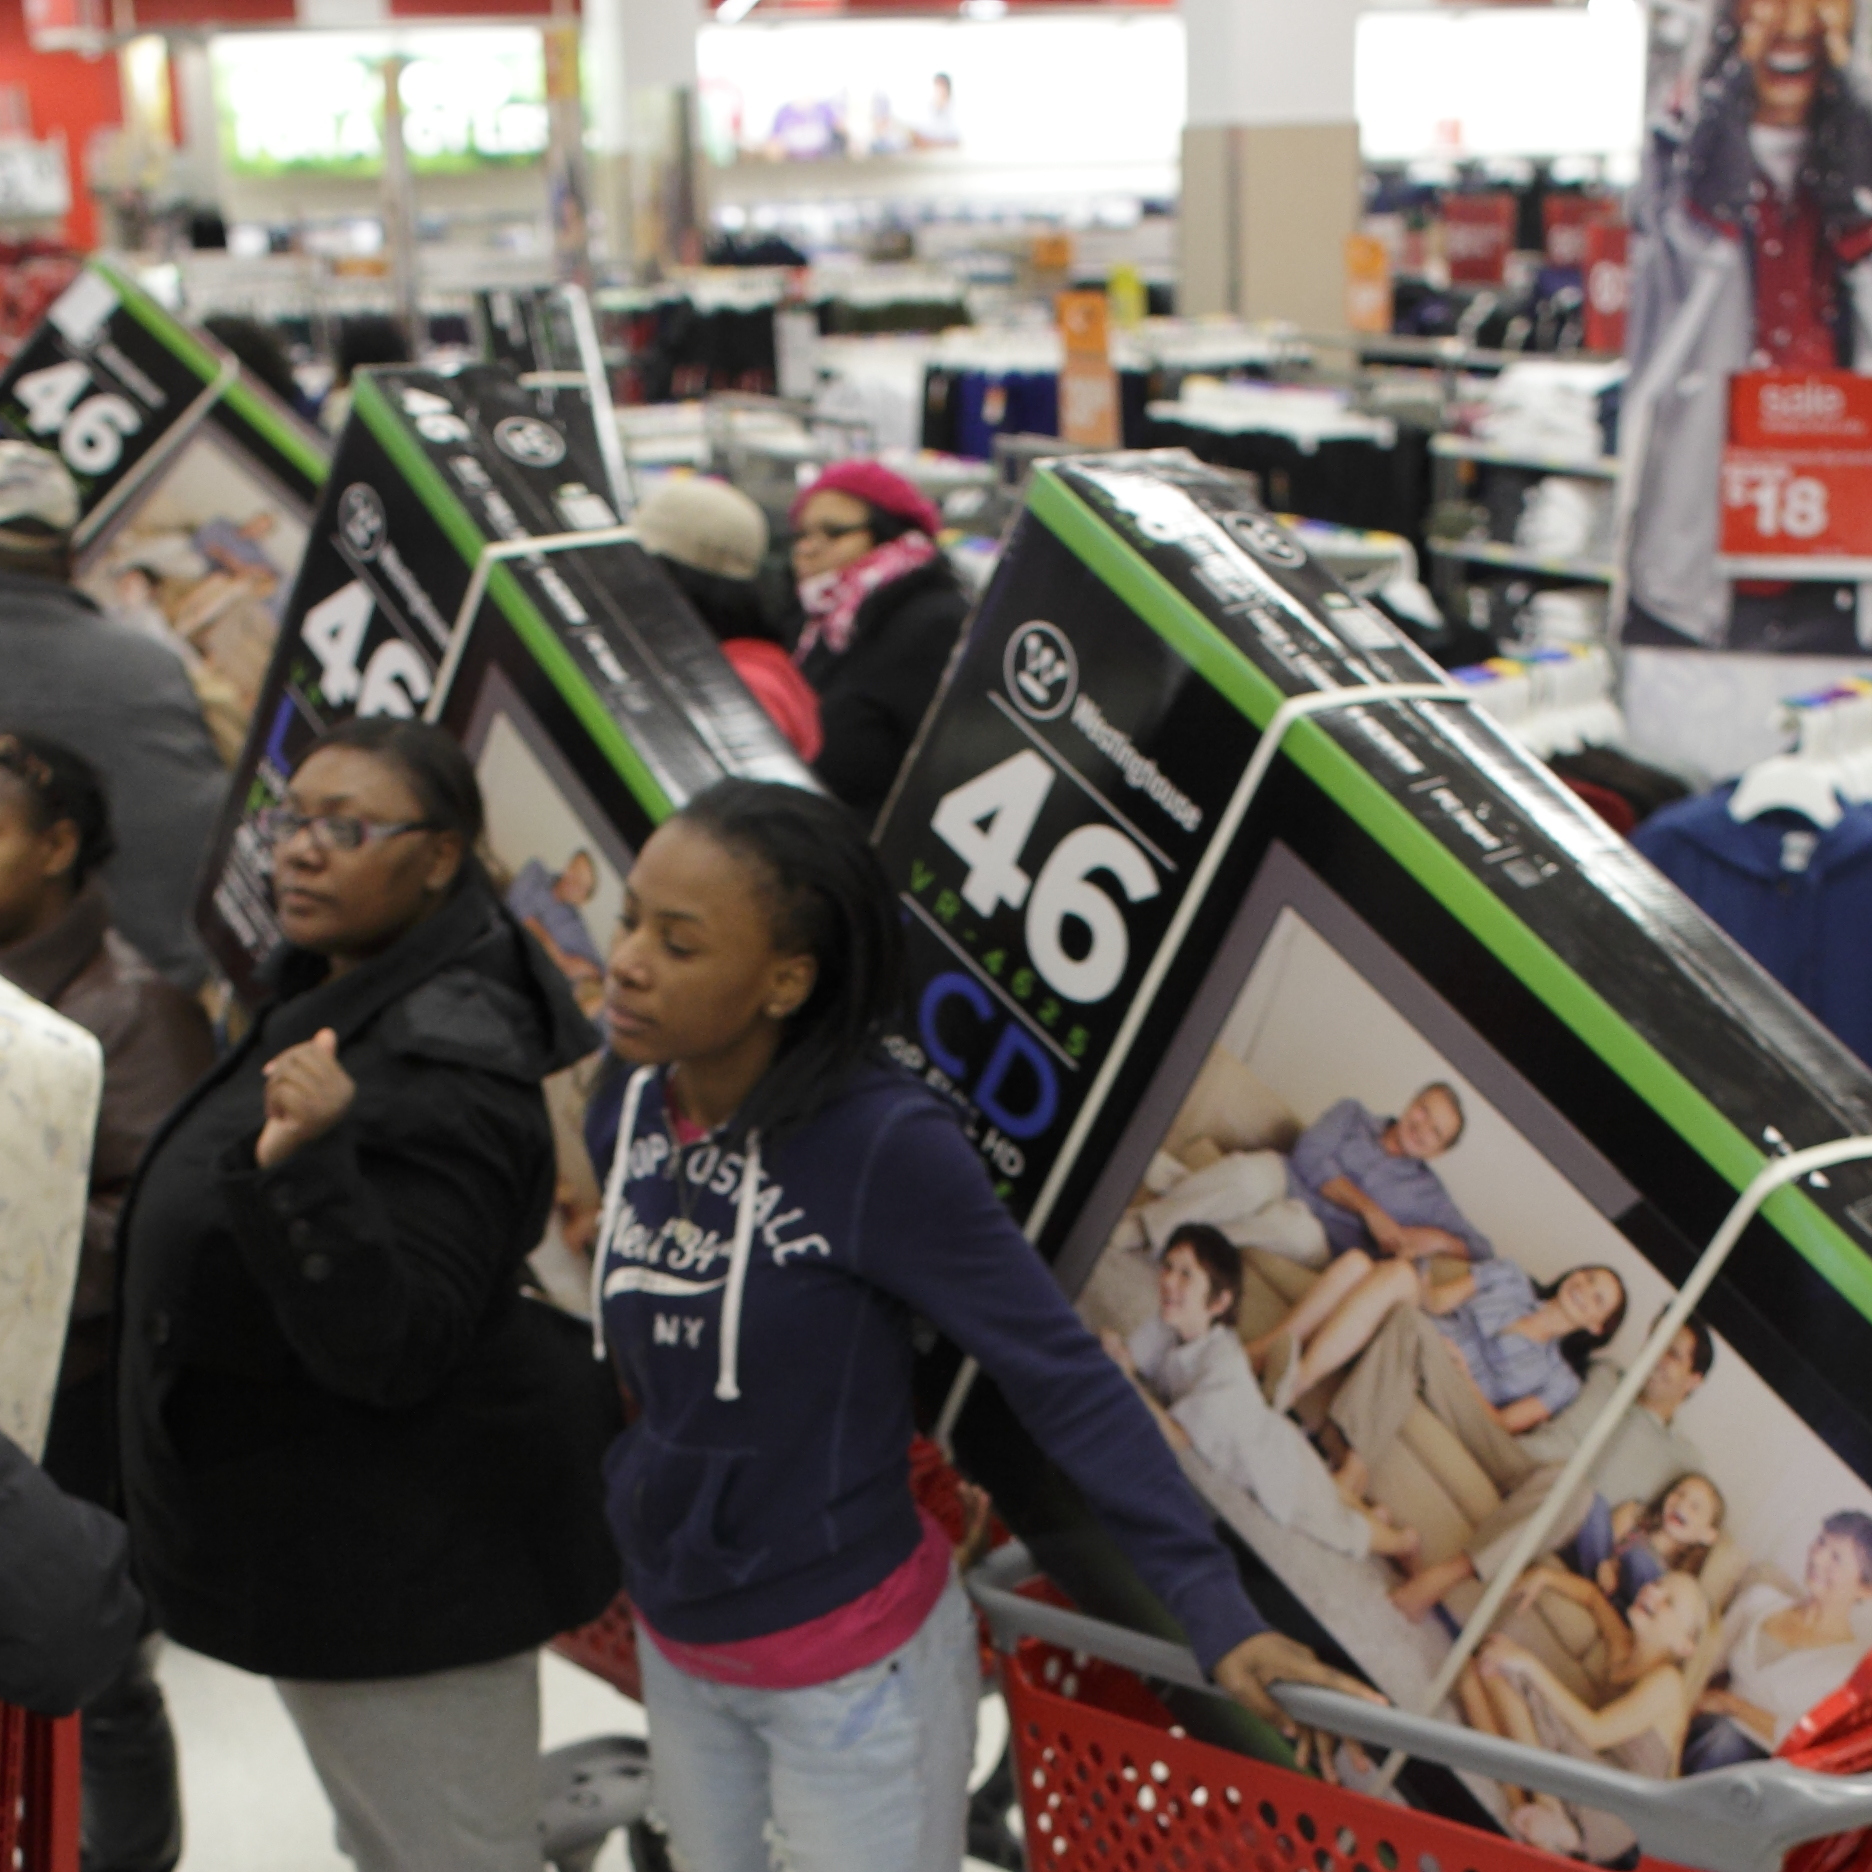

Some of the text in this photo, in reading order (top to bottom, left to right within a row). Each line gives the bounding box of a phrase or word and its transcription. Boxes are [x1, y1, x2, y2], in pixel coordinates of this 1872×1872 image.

[12, 358, 144, 477] 46
[1758, 374, 1848, 416] sale
[1069, 692, 1203, 834] Westinghouse
[930, 747, 1162, 1004] 46
[908, 858, 1091, 1059] VR-4625
[917, 970, 1062, 1140] CD
[652, 1311, 707, 1350] NY
